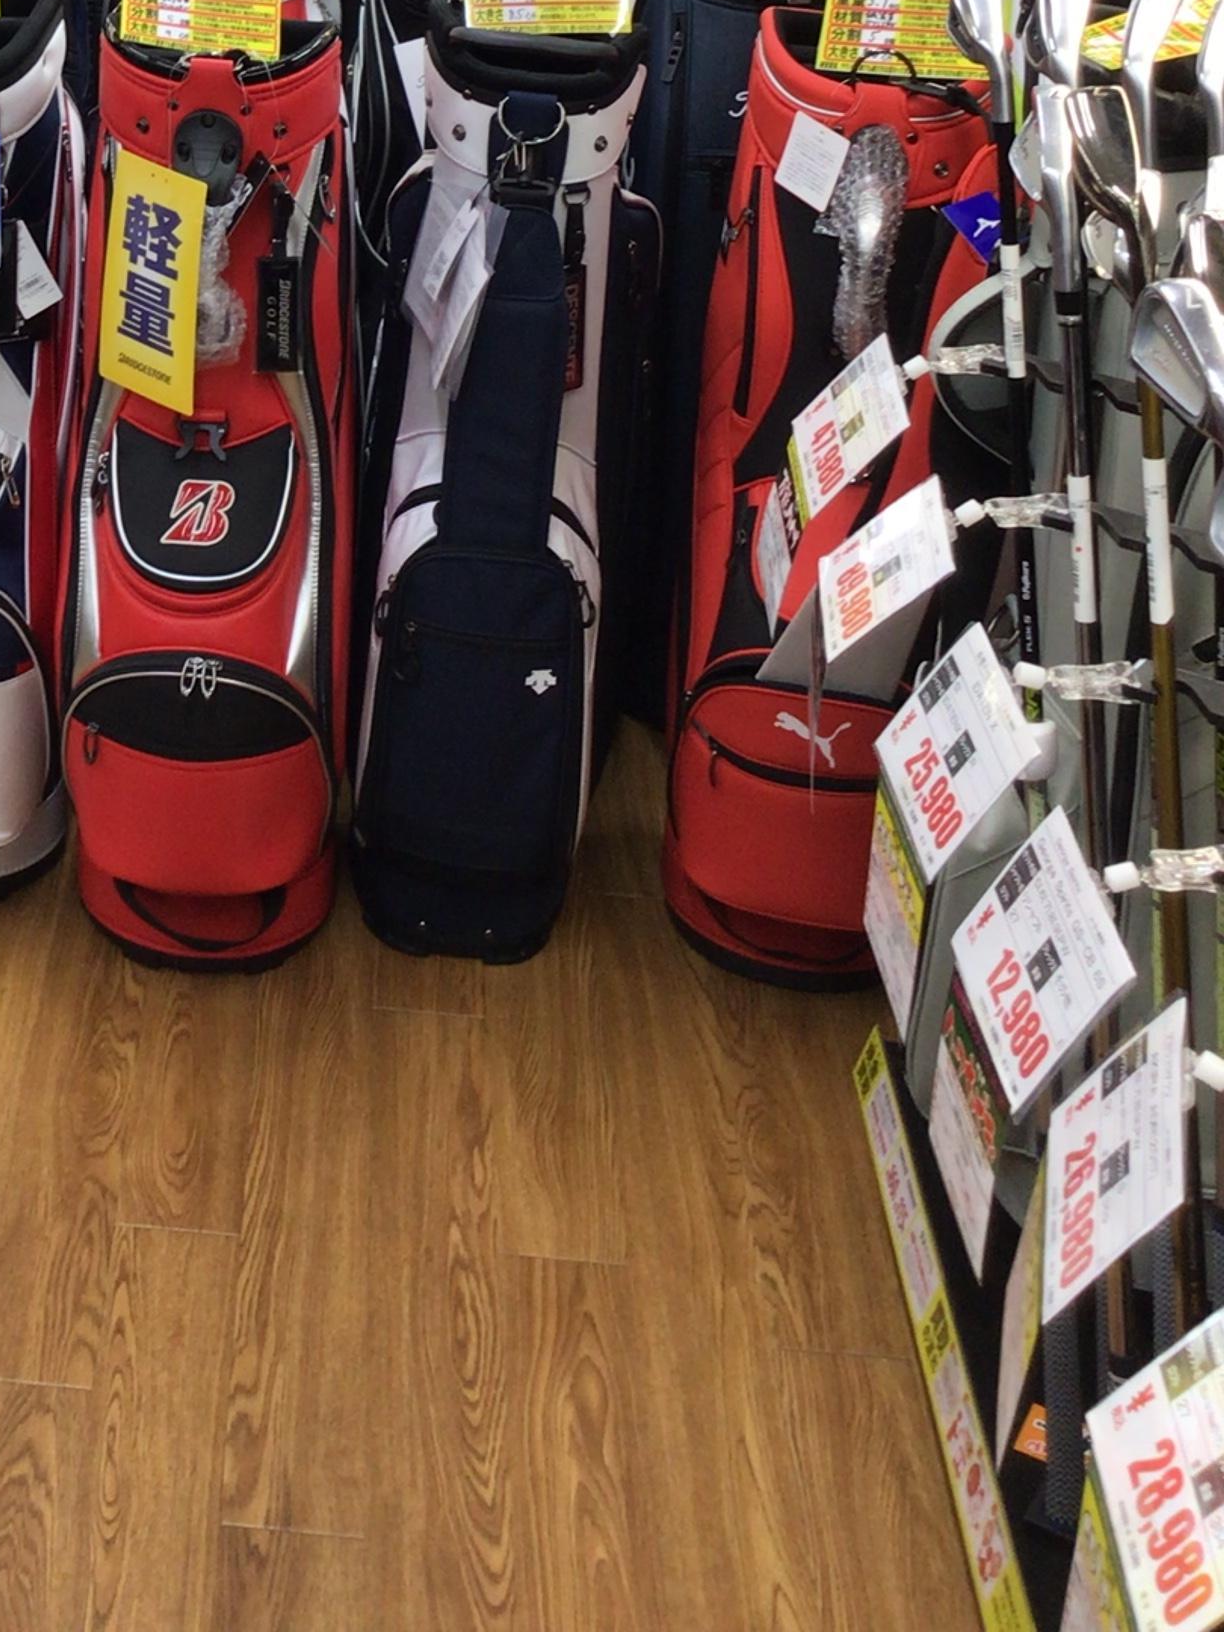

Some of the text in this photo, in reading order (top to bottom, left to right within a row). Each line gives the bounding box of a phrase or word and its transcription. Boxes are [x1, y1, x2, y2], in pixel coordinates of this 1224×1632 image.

[117, 194, 183, 357] 軽量
[809, 416, 844, 499] 47,980
[904, 737, 963, 850] 25,980
[986, 948, 1050, 1078] 12,980
[1059, 1132, 1096, 1289] 26,980
[1128, 1438, 1214, 1626] 28,980
